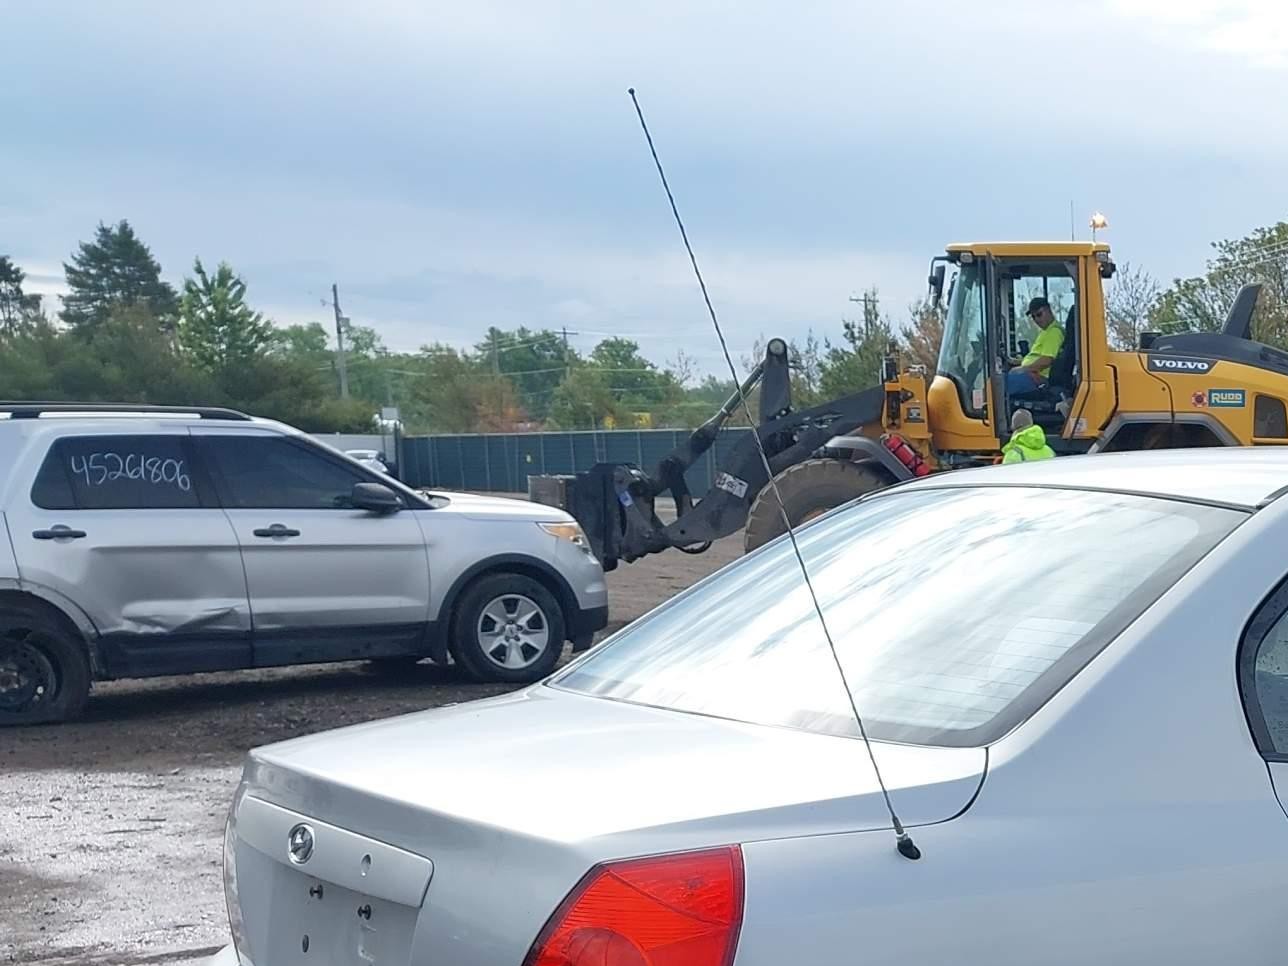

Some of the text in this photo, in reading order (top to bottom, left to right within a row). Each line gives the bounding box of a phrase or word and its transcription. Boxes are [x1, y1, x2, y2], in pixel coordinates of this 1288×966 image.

[1152, 358, 1209, 370] VOLVO
[1211, 392, 1244, 403] RUDD
[70, 452, 191, 491] 45261806
